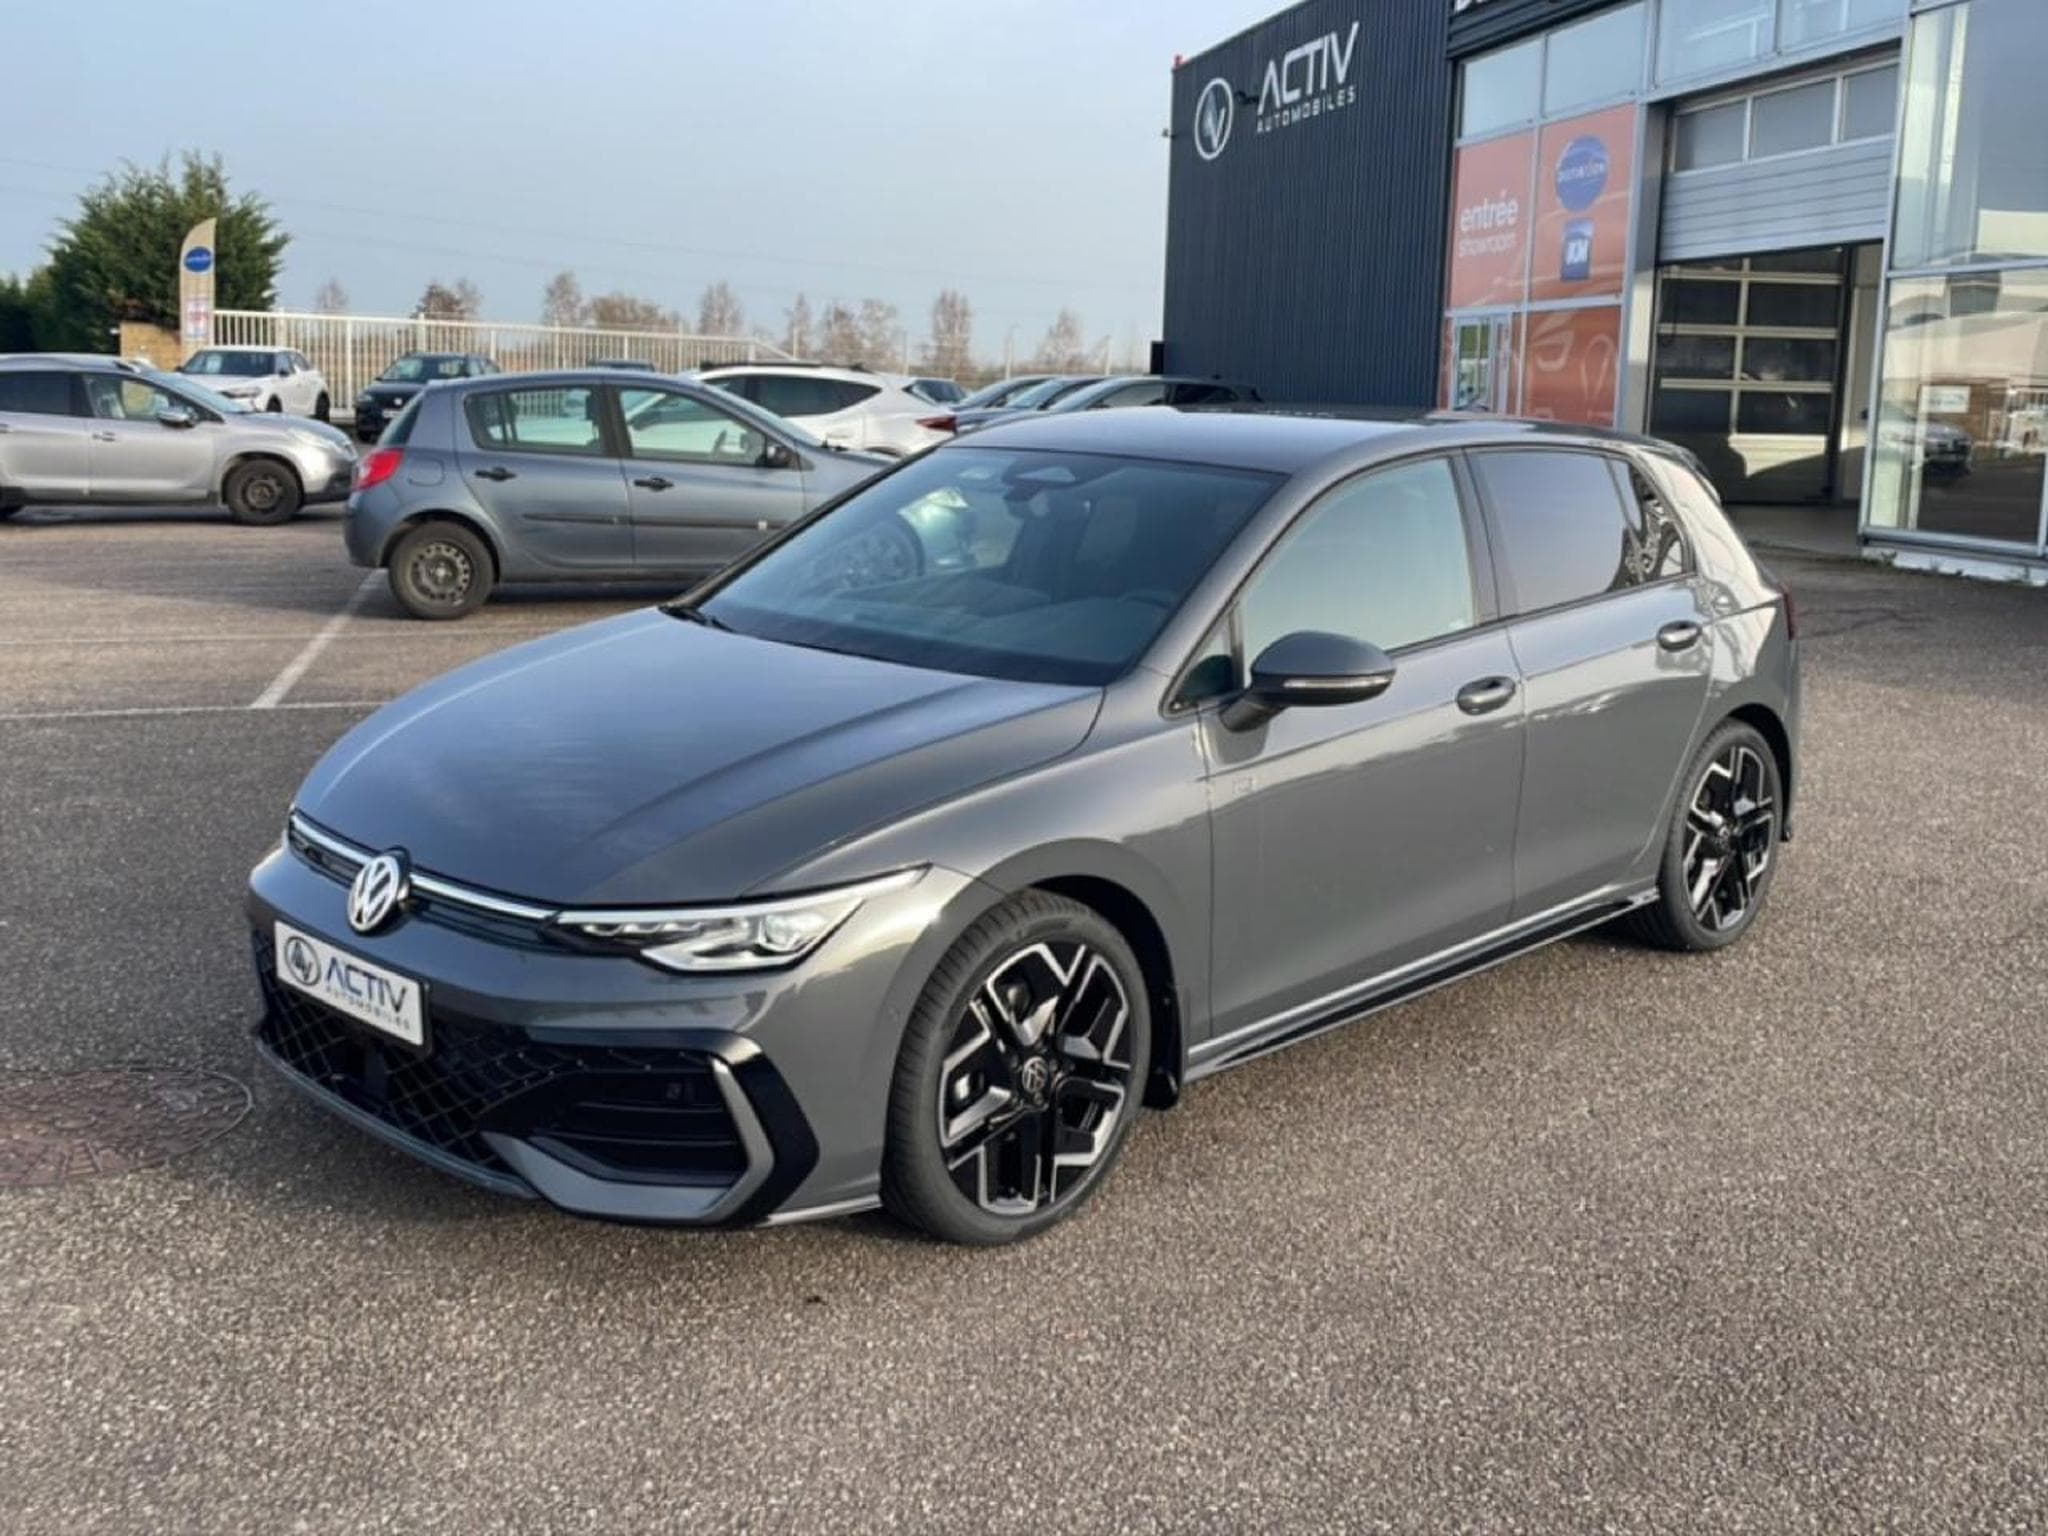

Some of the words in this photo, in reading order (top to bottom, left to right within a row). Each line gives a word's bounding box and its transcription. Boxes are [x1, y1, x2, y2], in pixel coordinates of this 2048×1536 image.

[1257, 21, 1360, 116] ACTIV
[1257, 85, 1356, 133] AUTOMOBILES
[1460, 189, 1519, 232] entrée
[326, 956, 407, 1013] ACTIV
